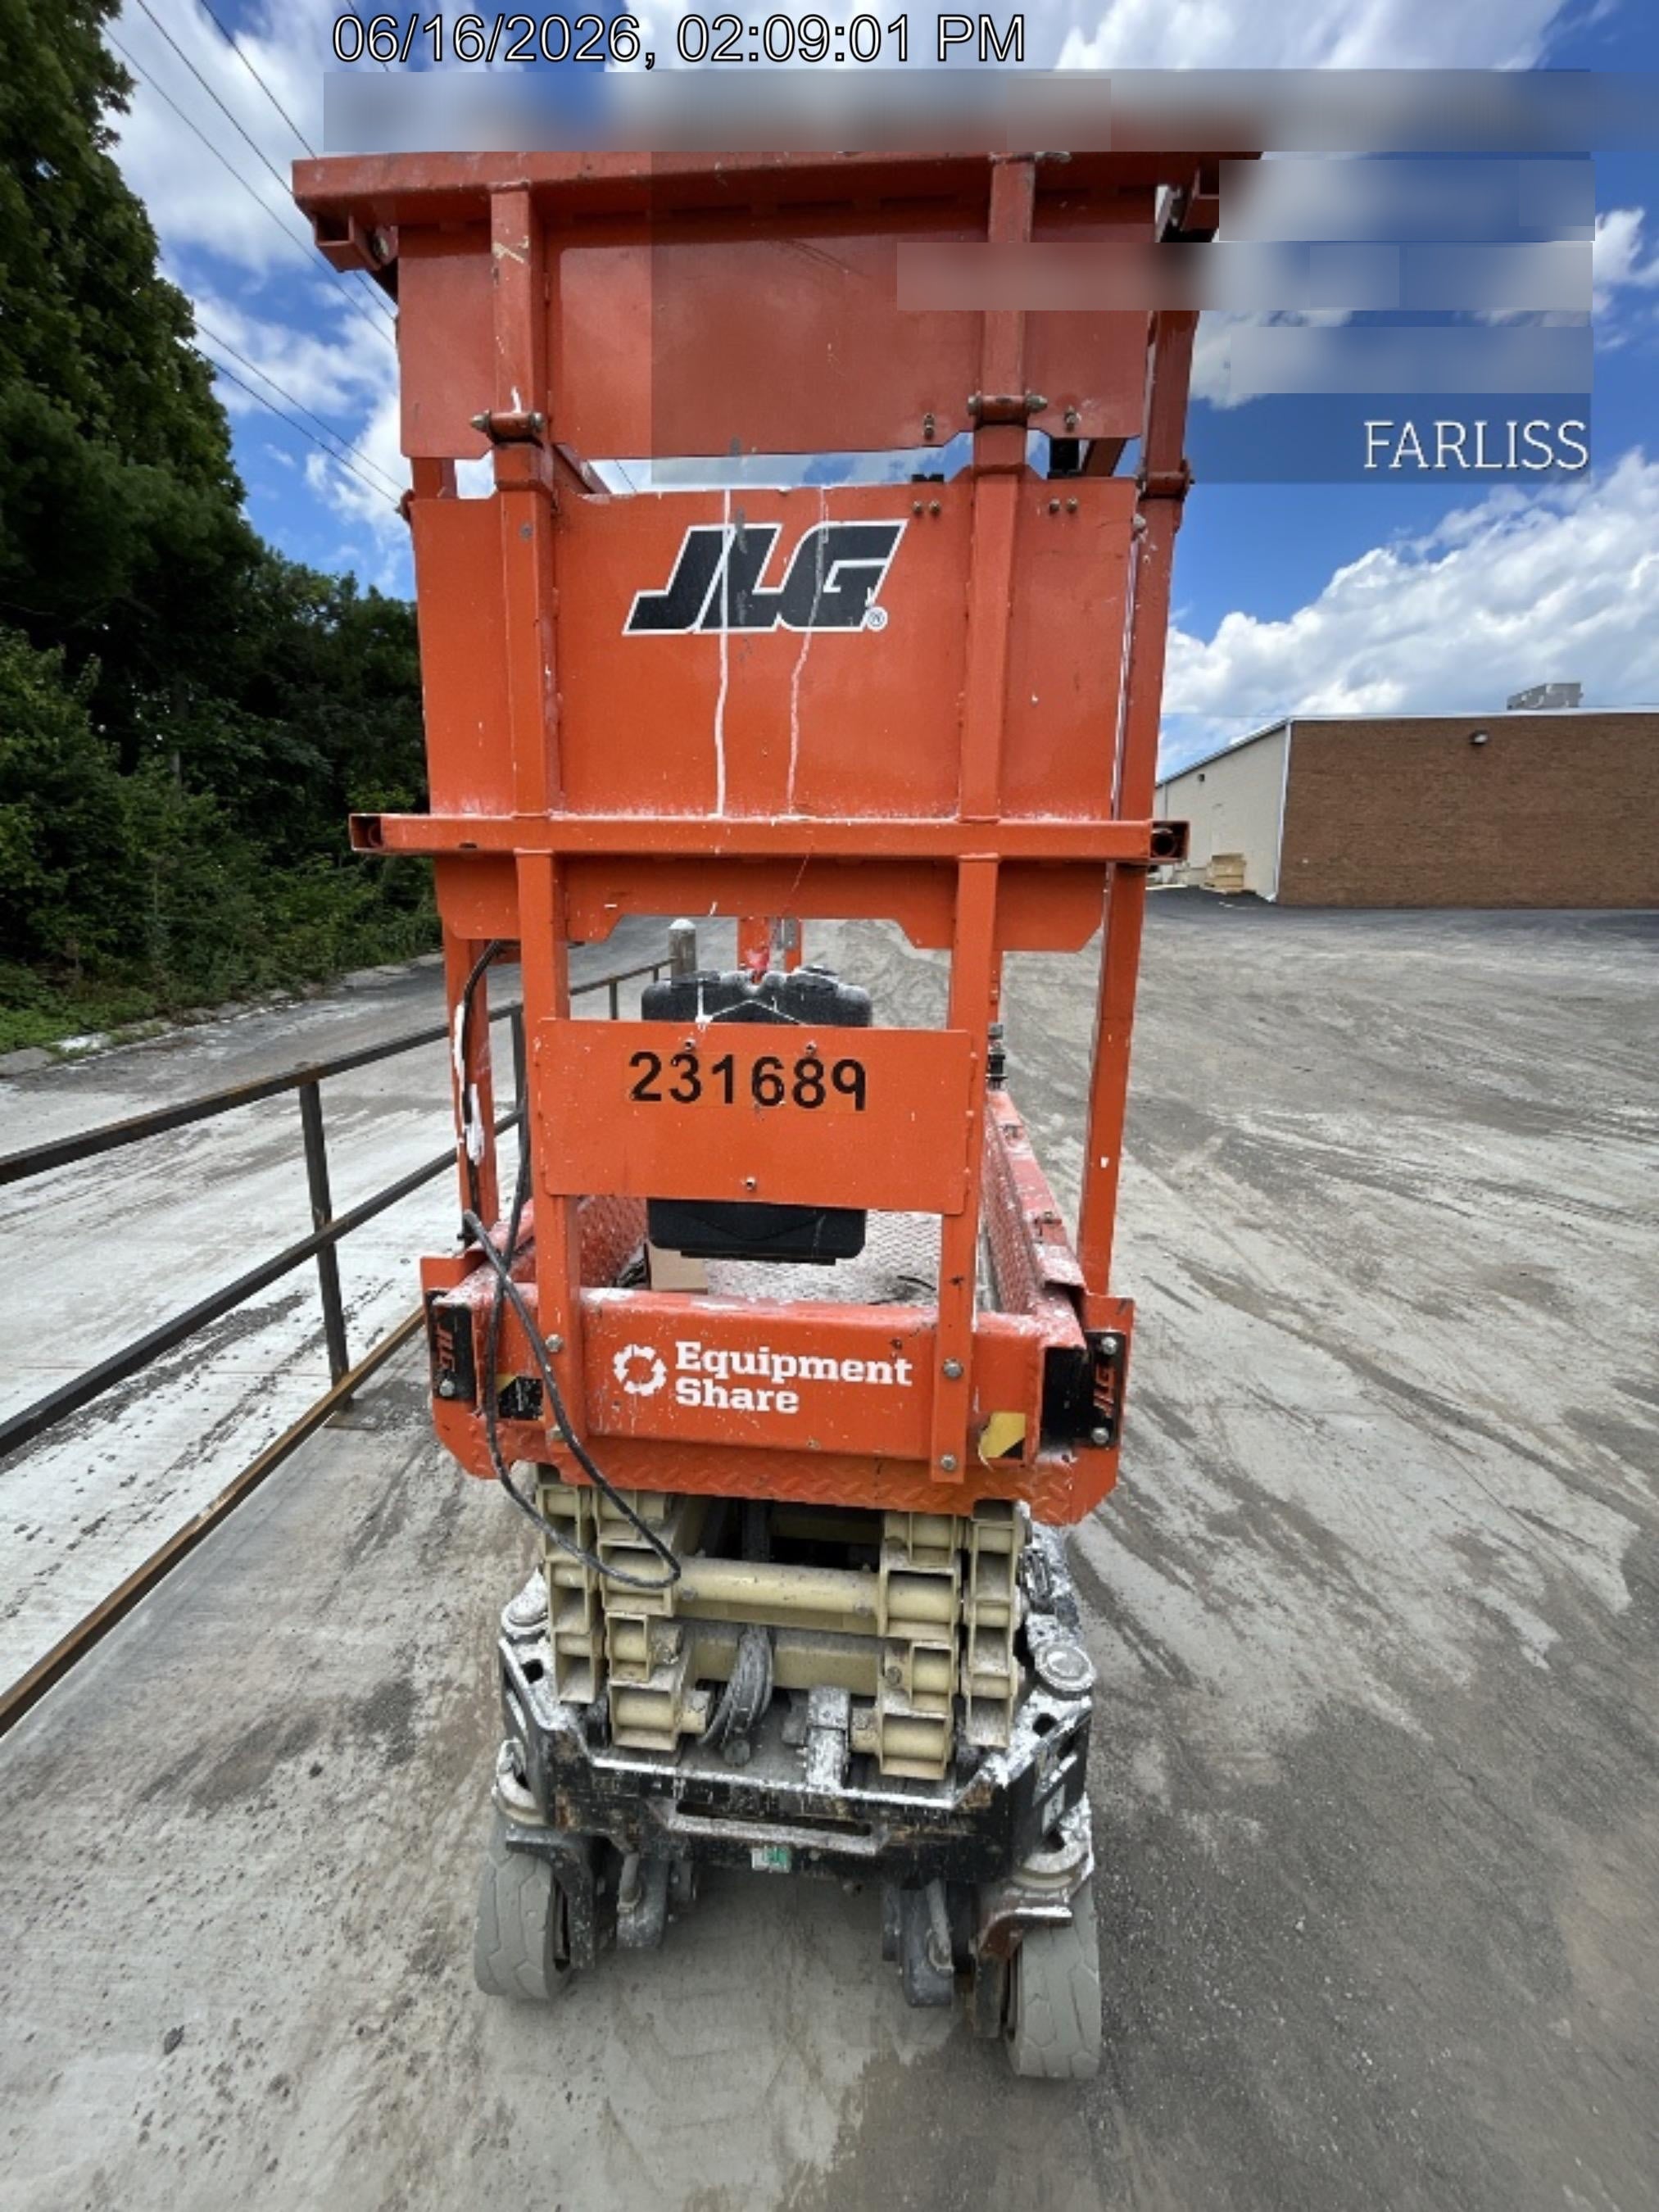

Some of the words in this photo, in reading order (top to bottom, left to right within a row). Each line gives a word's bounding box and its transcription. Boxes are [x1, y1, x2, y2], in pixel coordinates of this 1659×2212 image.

[629, 1051, 866, 1111] 231689
[675, 1341, 913, 1386] Equipment
[675, 1377, 799, 1414] Share
